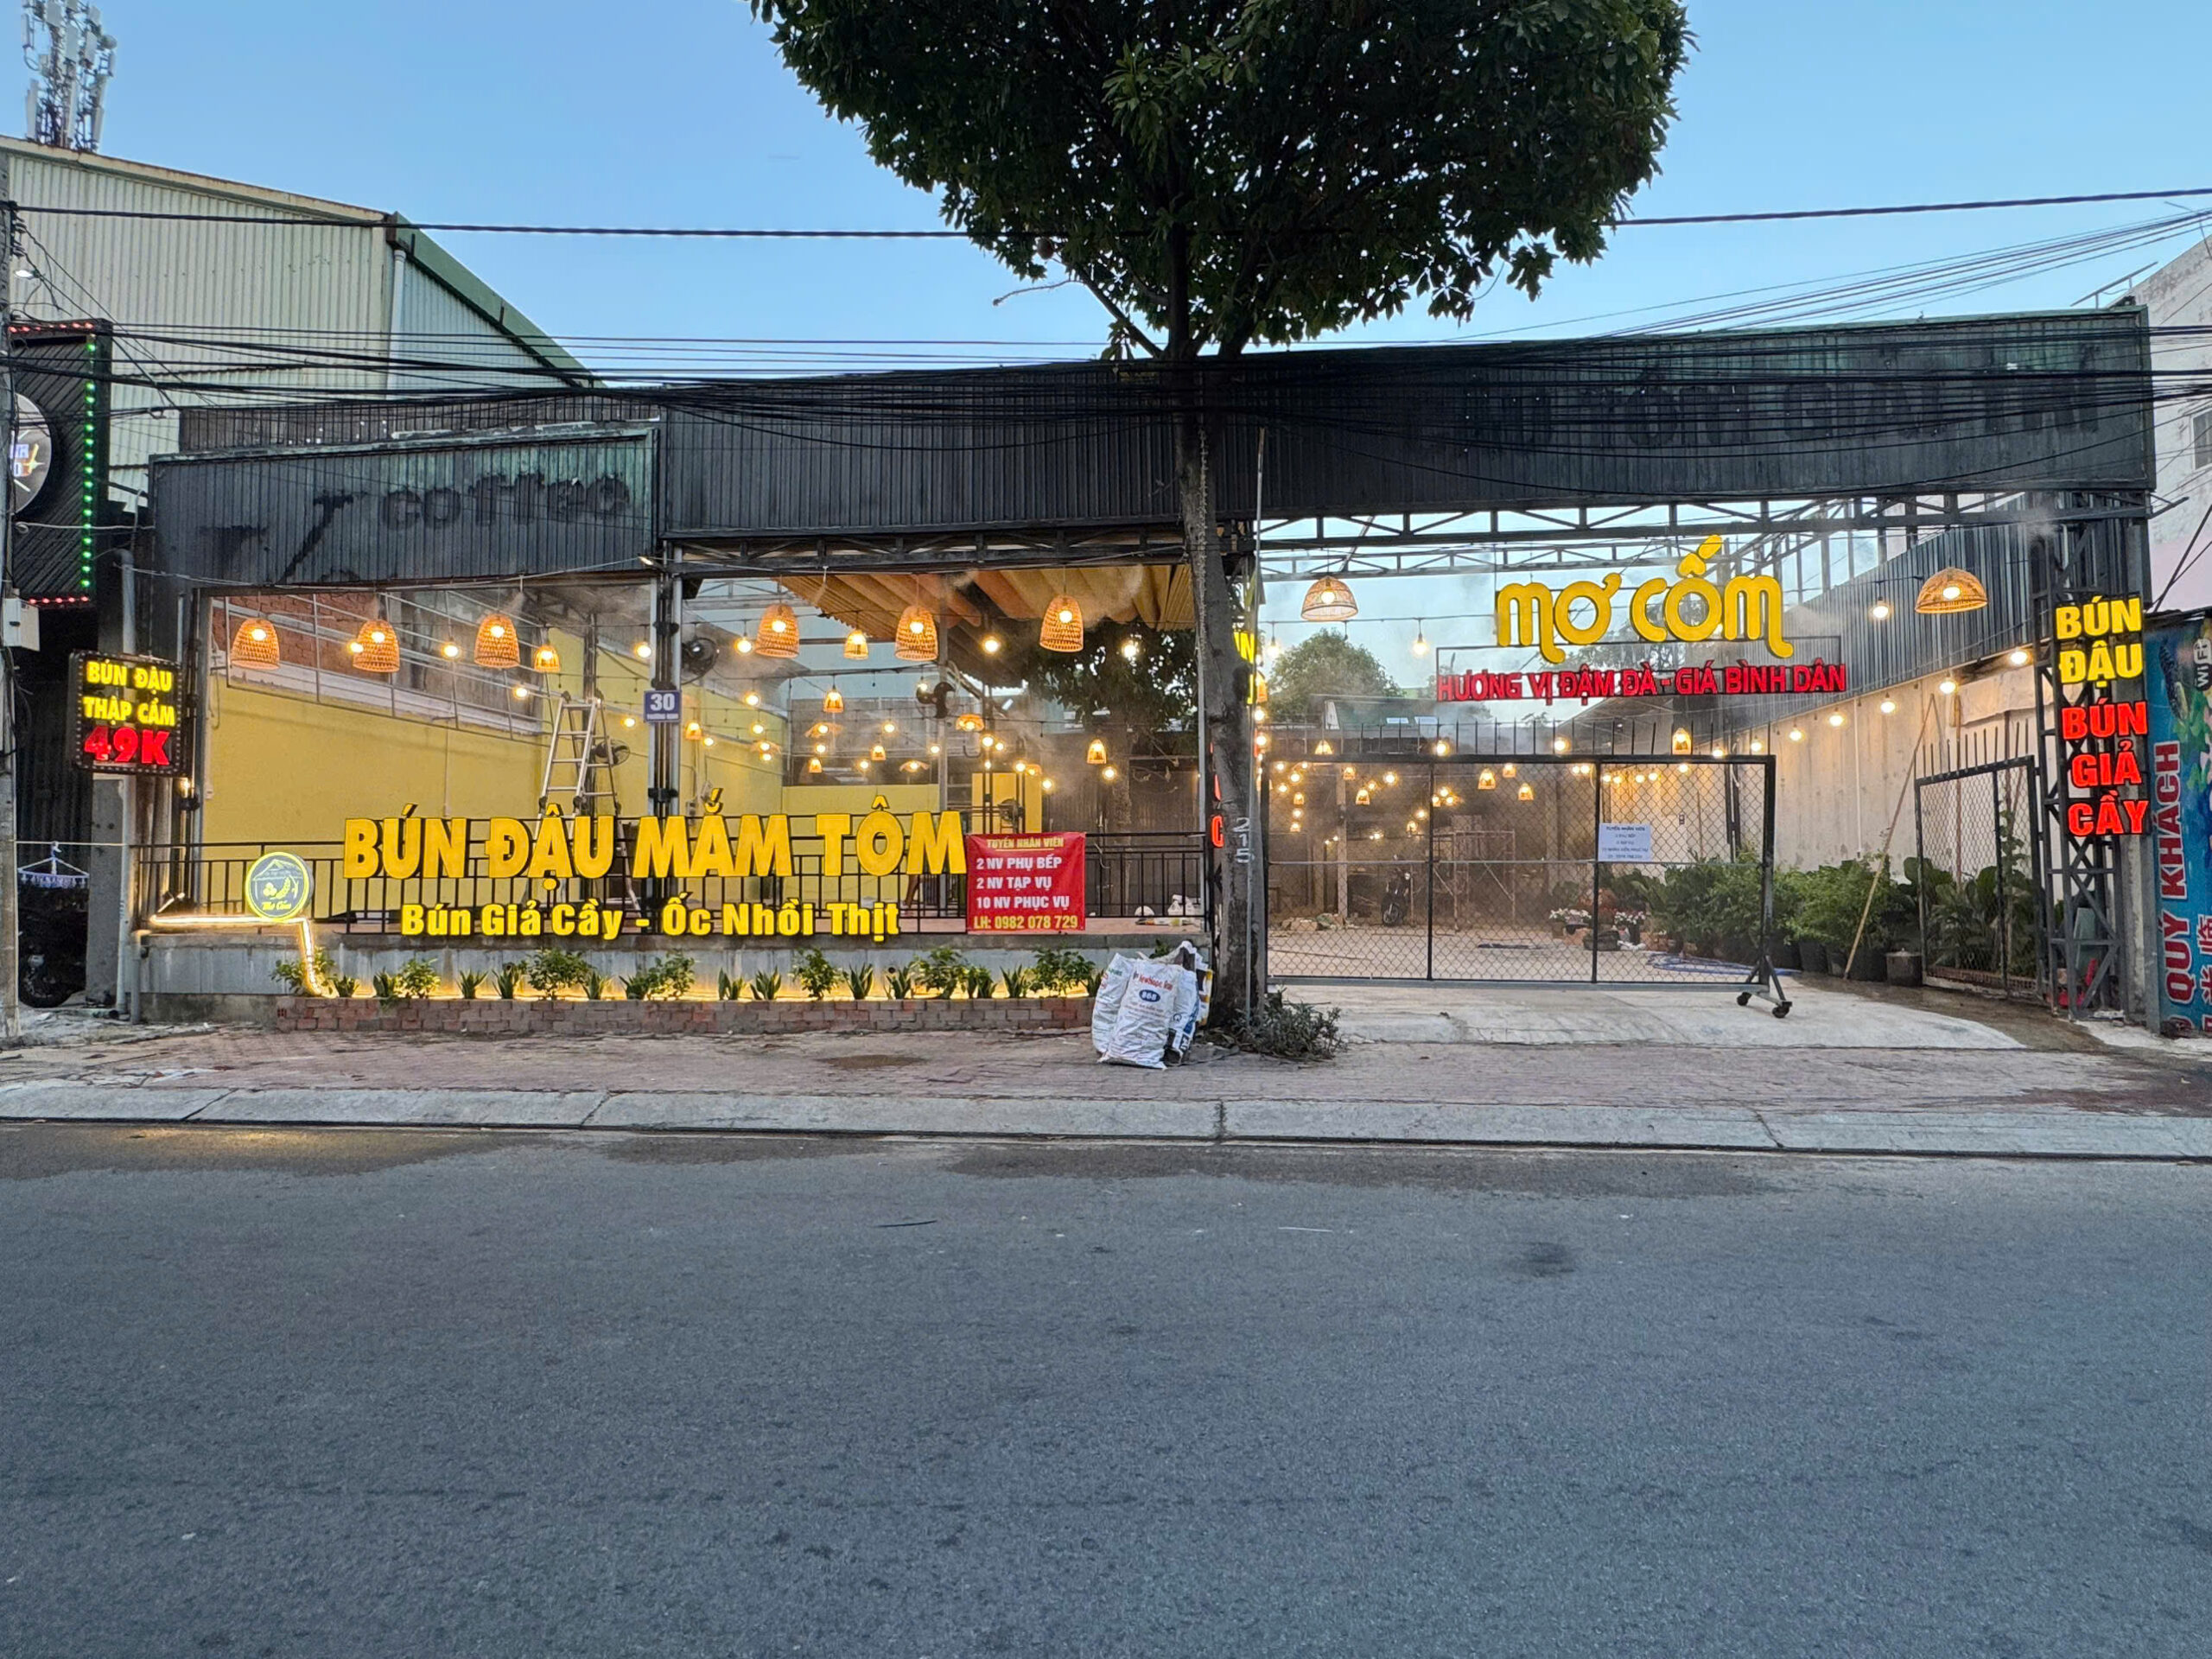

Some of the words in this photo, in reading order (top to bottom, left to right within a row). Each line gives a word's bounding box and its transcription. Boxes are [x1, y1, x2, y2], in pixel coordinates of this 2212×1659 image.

[2056, 596, 2142, 639] BÚN
[86, 658, 128, 686] BÚN
[133, 665, 172, 695] ĐẬU
[1437, 670, 1522, 702] HƯƠNG
[1529, 671, 1554, 706] VỊ
[1559, 664, 1615, 706] ĐẬM
[1621, 660, 1658, 695] ĐÀ
[1675, 660, 1718, 695] GIÁ
[1724, 658, 1787, 694] BÌNH
[1793, 658, 1847, 692] DÂN
[2058, 640, 2143, 688] ĐẬU
[83, 695, 131, 725] THẬP
[650, 693, 675, 711] 30
[2061, 698, 2148, 741] BÚN
[84, 725, 170, 766] 49K
[2071, 741, 2142, 788] GIẢ
[2068, 790, 2149, 836] CẦY
[2153, 740, 2187, 899] KHÁCH
[343, 804, 469, 880] BÚN
[486, 803, 616, 891] ĐẬU
[632, 788, 795, 879] MẮM
[816, 795, 968, 877] TÔM
[976, 858, 984, 870] 2
[986, 857, 1003, 869] NV
[1007, 857, 1033, 871] PHỤ
[1037, 853, 1062, 869] BẾP
[976, 878, 984, 889] 2
[987, 877, 1003, 889] NV
[1007, 877, 1031, 891] TẠP
[1035, 876, 1052, 891] VỤ
[401, 902, 472, 937] Bún
[481, 899, 542, 937] Giả
[551, 897, 623, 940] Cầy
[662, 892, 712, 937] Ốc
[723, 898, 815, 937] Nhồi
[827, 901, 900, 943] Thịt
[976, 897, 991, 908] 10
[994, 897, 1011, 909] NV
[1014, 896, 1049, 911] PHỤC
[1052, 896, 1070, 911] VỤ
[995, 915, 1025, 930] 0982
[1027, 915, 1052, 930] 078
[1054, 915, 1079, 930] 729
[2158, 909, 2196, 1003] QUÝ
